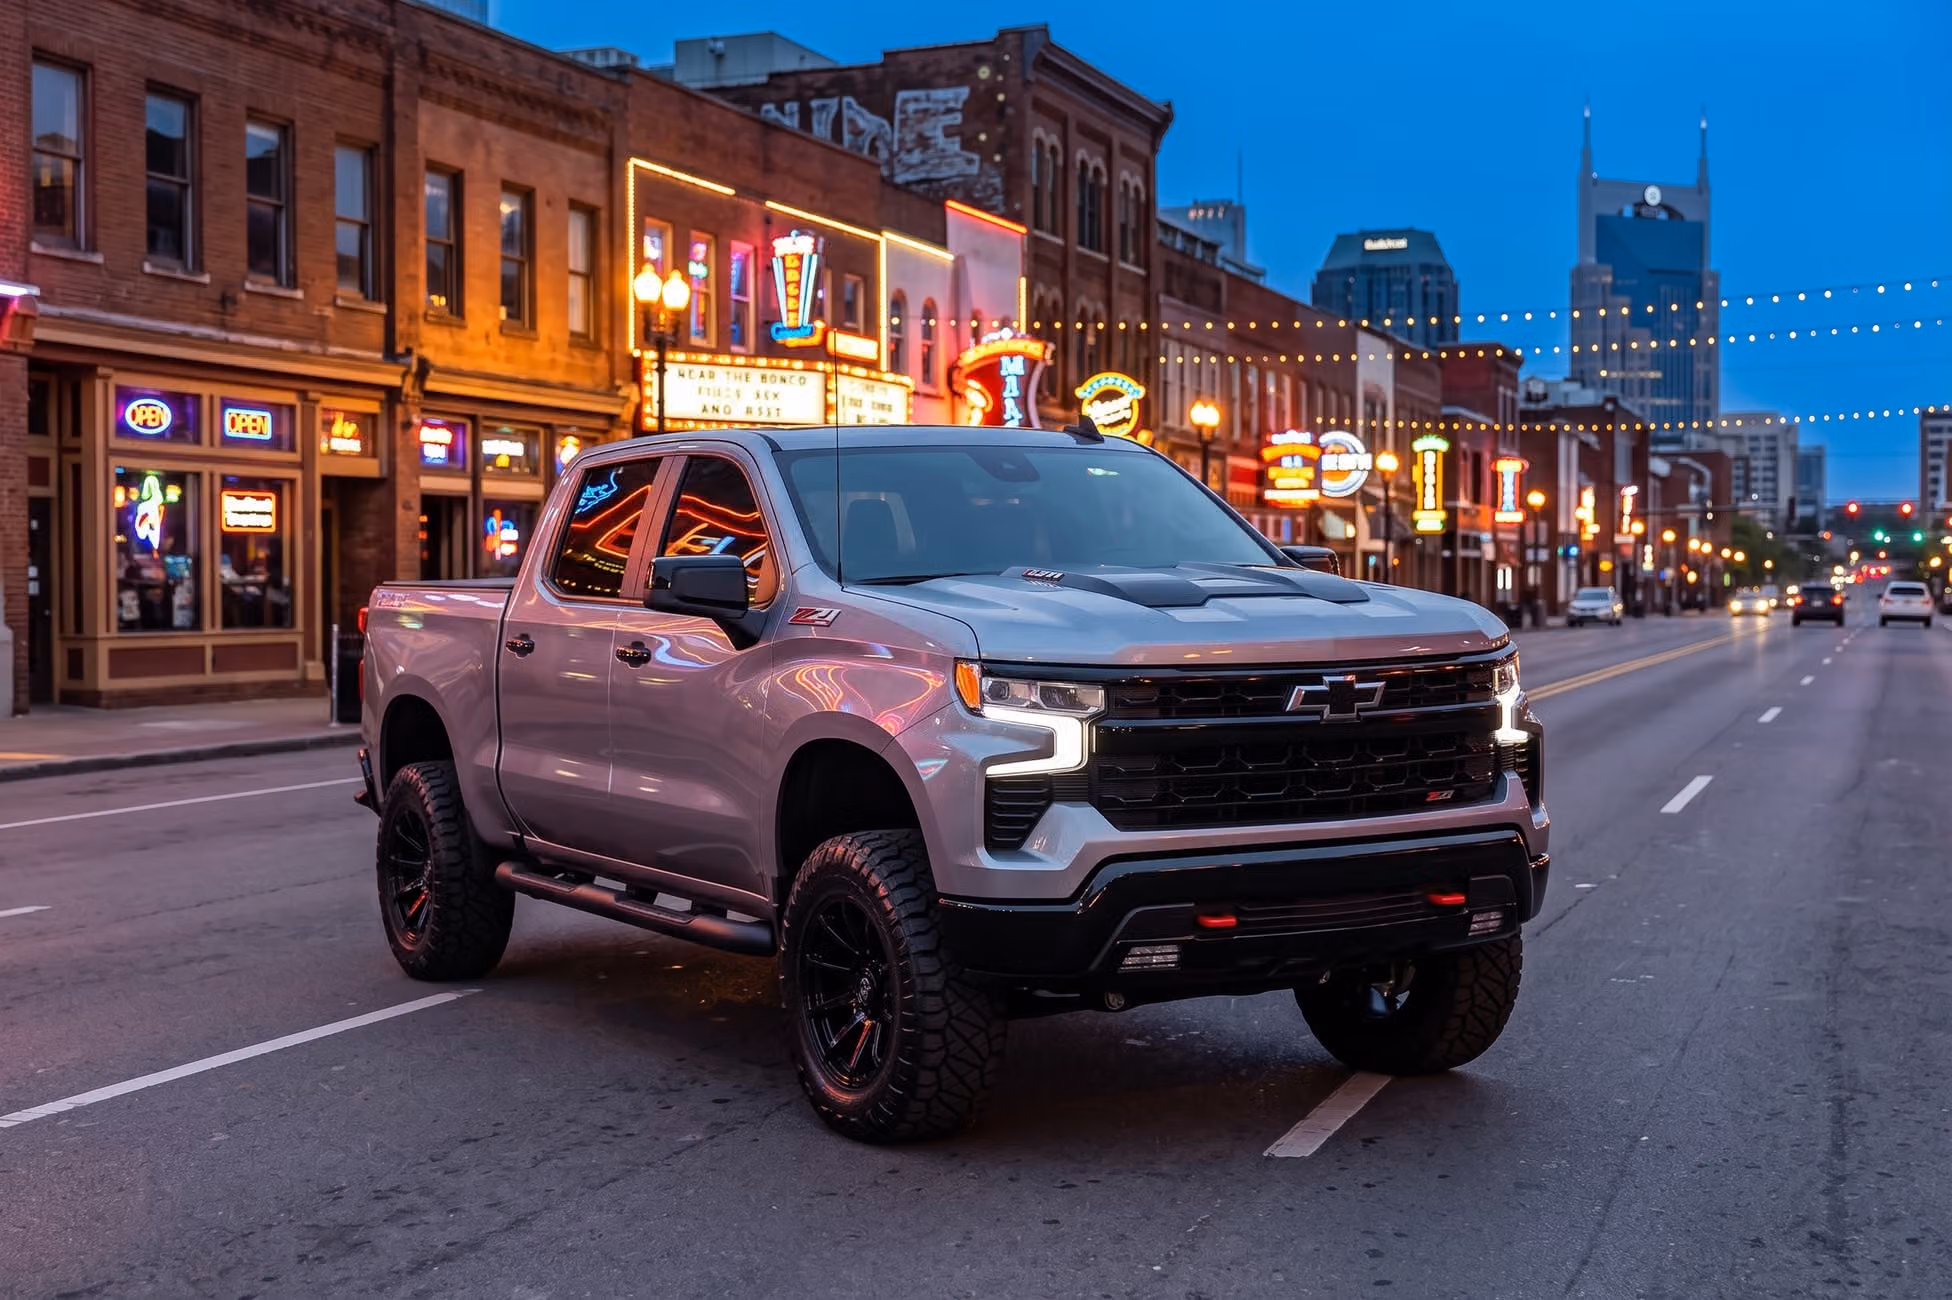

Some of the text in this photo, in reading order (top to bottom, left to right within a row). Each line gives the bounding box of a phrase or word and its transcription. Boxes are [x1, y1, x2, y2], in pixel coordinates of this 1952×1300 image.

[130, 405, 169, 427] OPEN
[228, 413, 268, 435] OPEN
[788, 606, 841, 626] Z71
